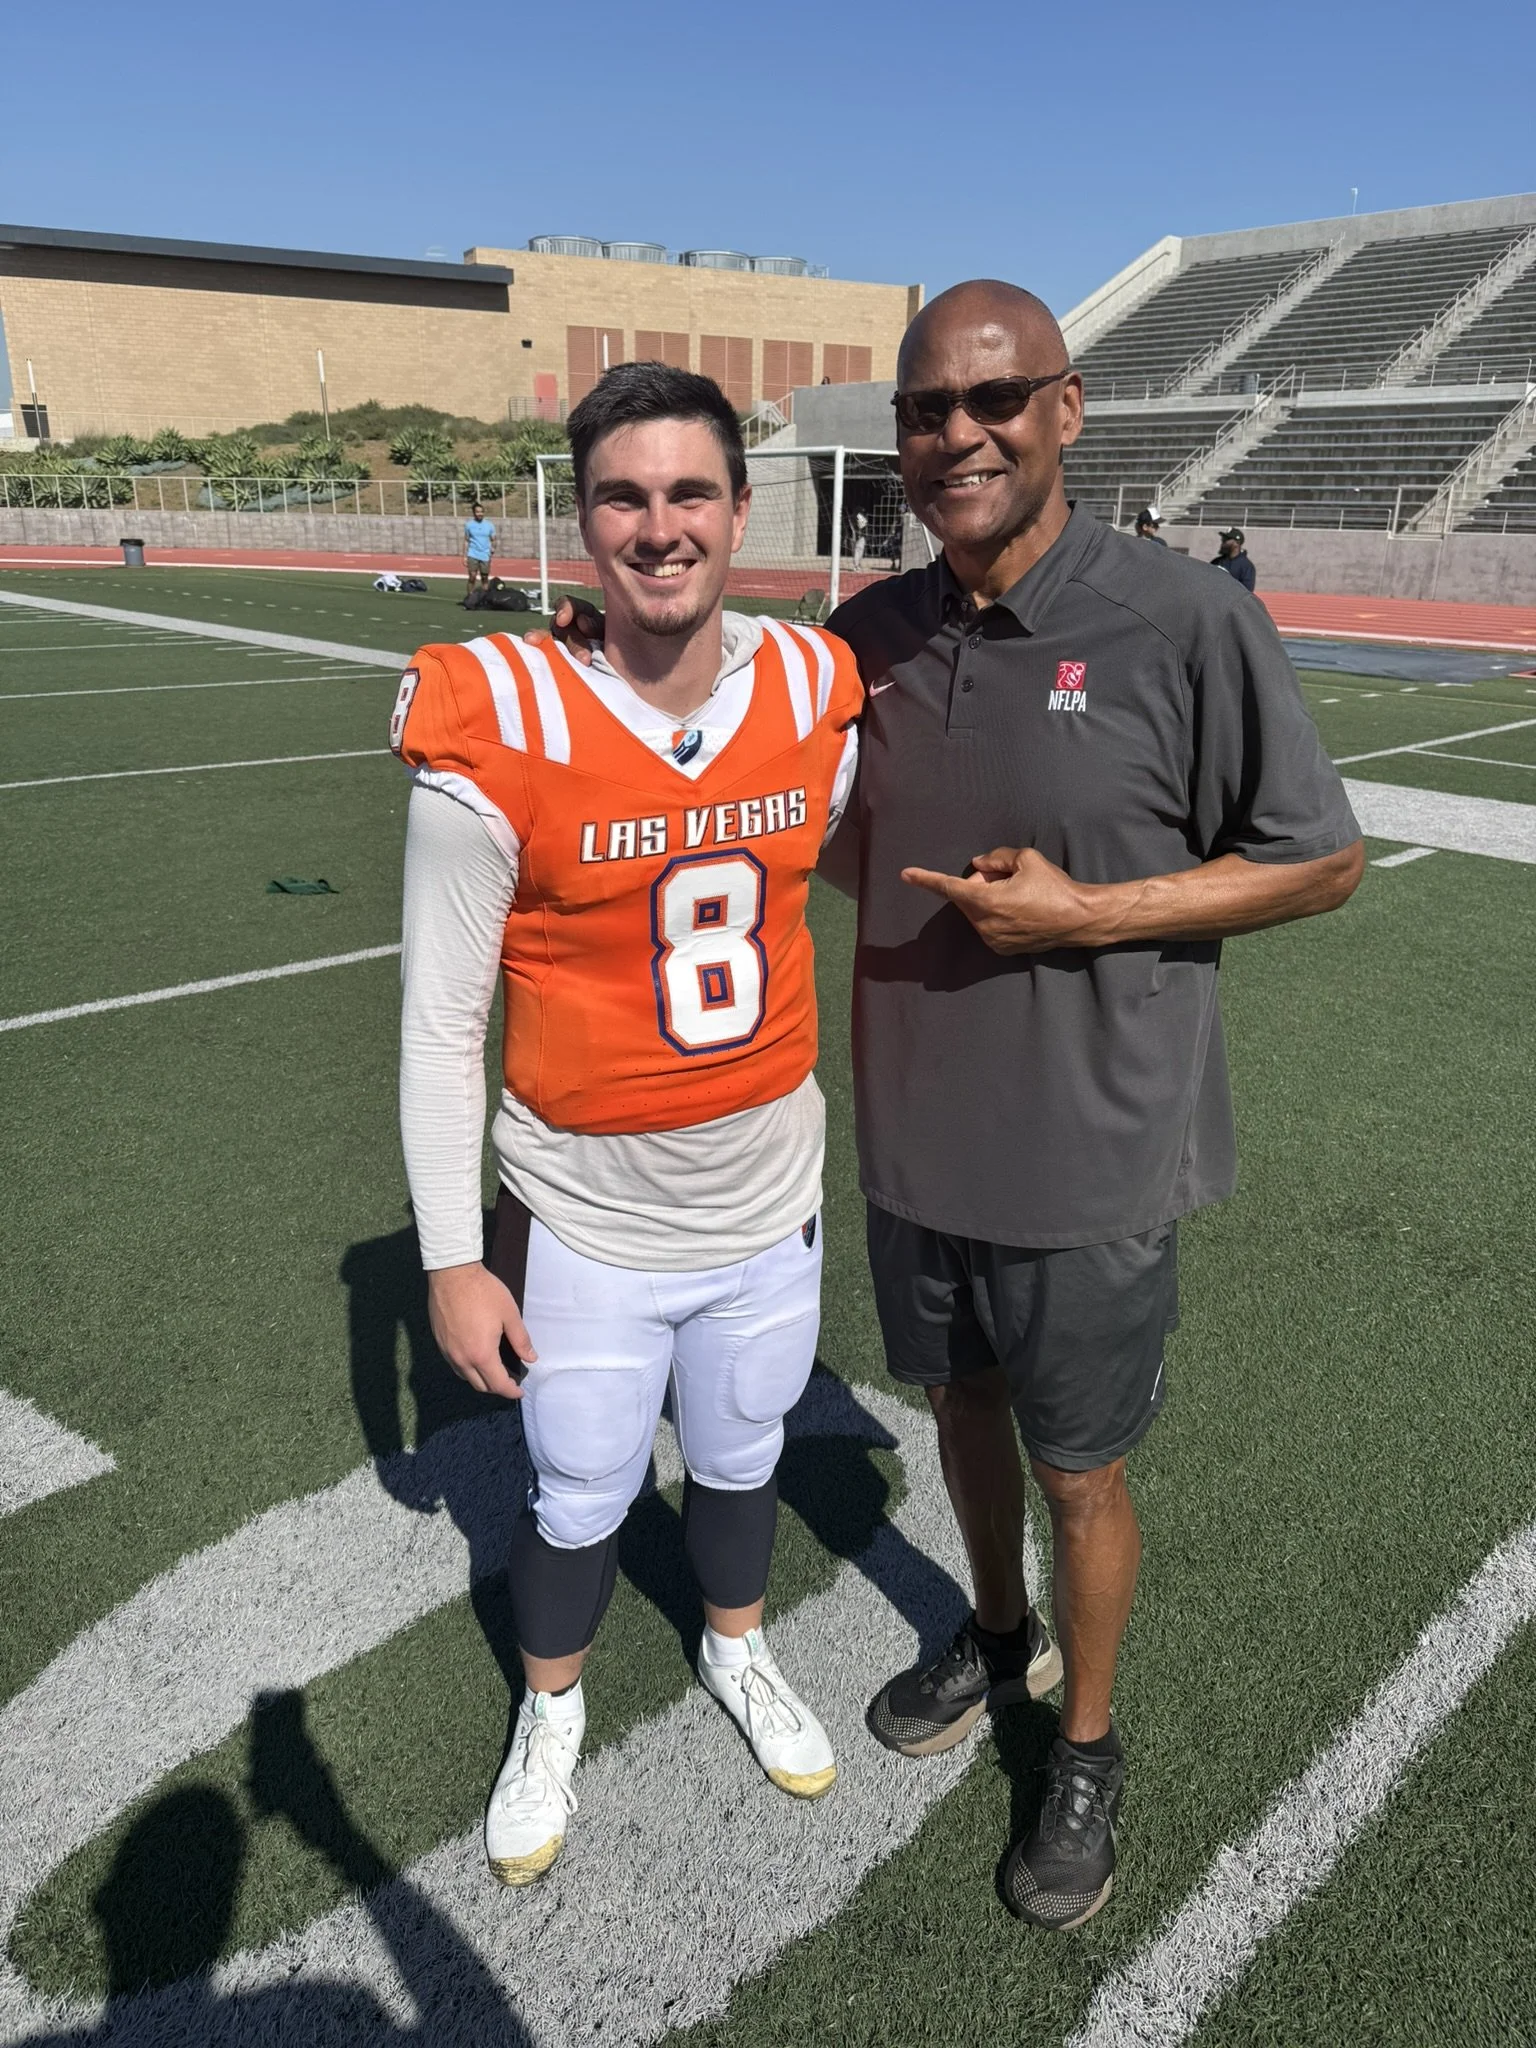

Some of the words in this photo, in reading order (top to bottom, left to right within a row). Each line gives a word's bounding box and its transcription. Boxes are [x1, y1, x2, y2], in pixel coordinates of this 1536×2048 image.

[389, 668, 420, 757] 8
[1048, 690, 1087, 712] NFLPA
[580, 814, 667, 864] LAS
[684, 786, 808, 849] VEGAS
[651, 847, 768, 1056] 8
